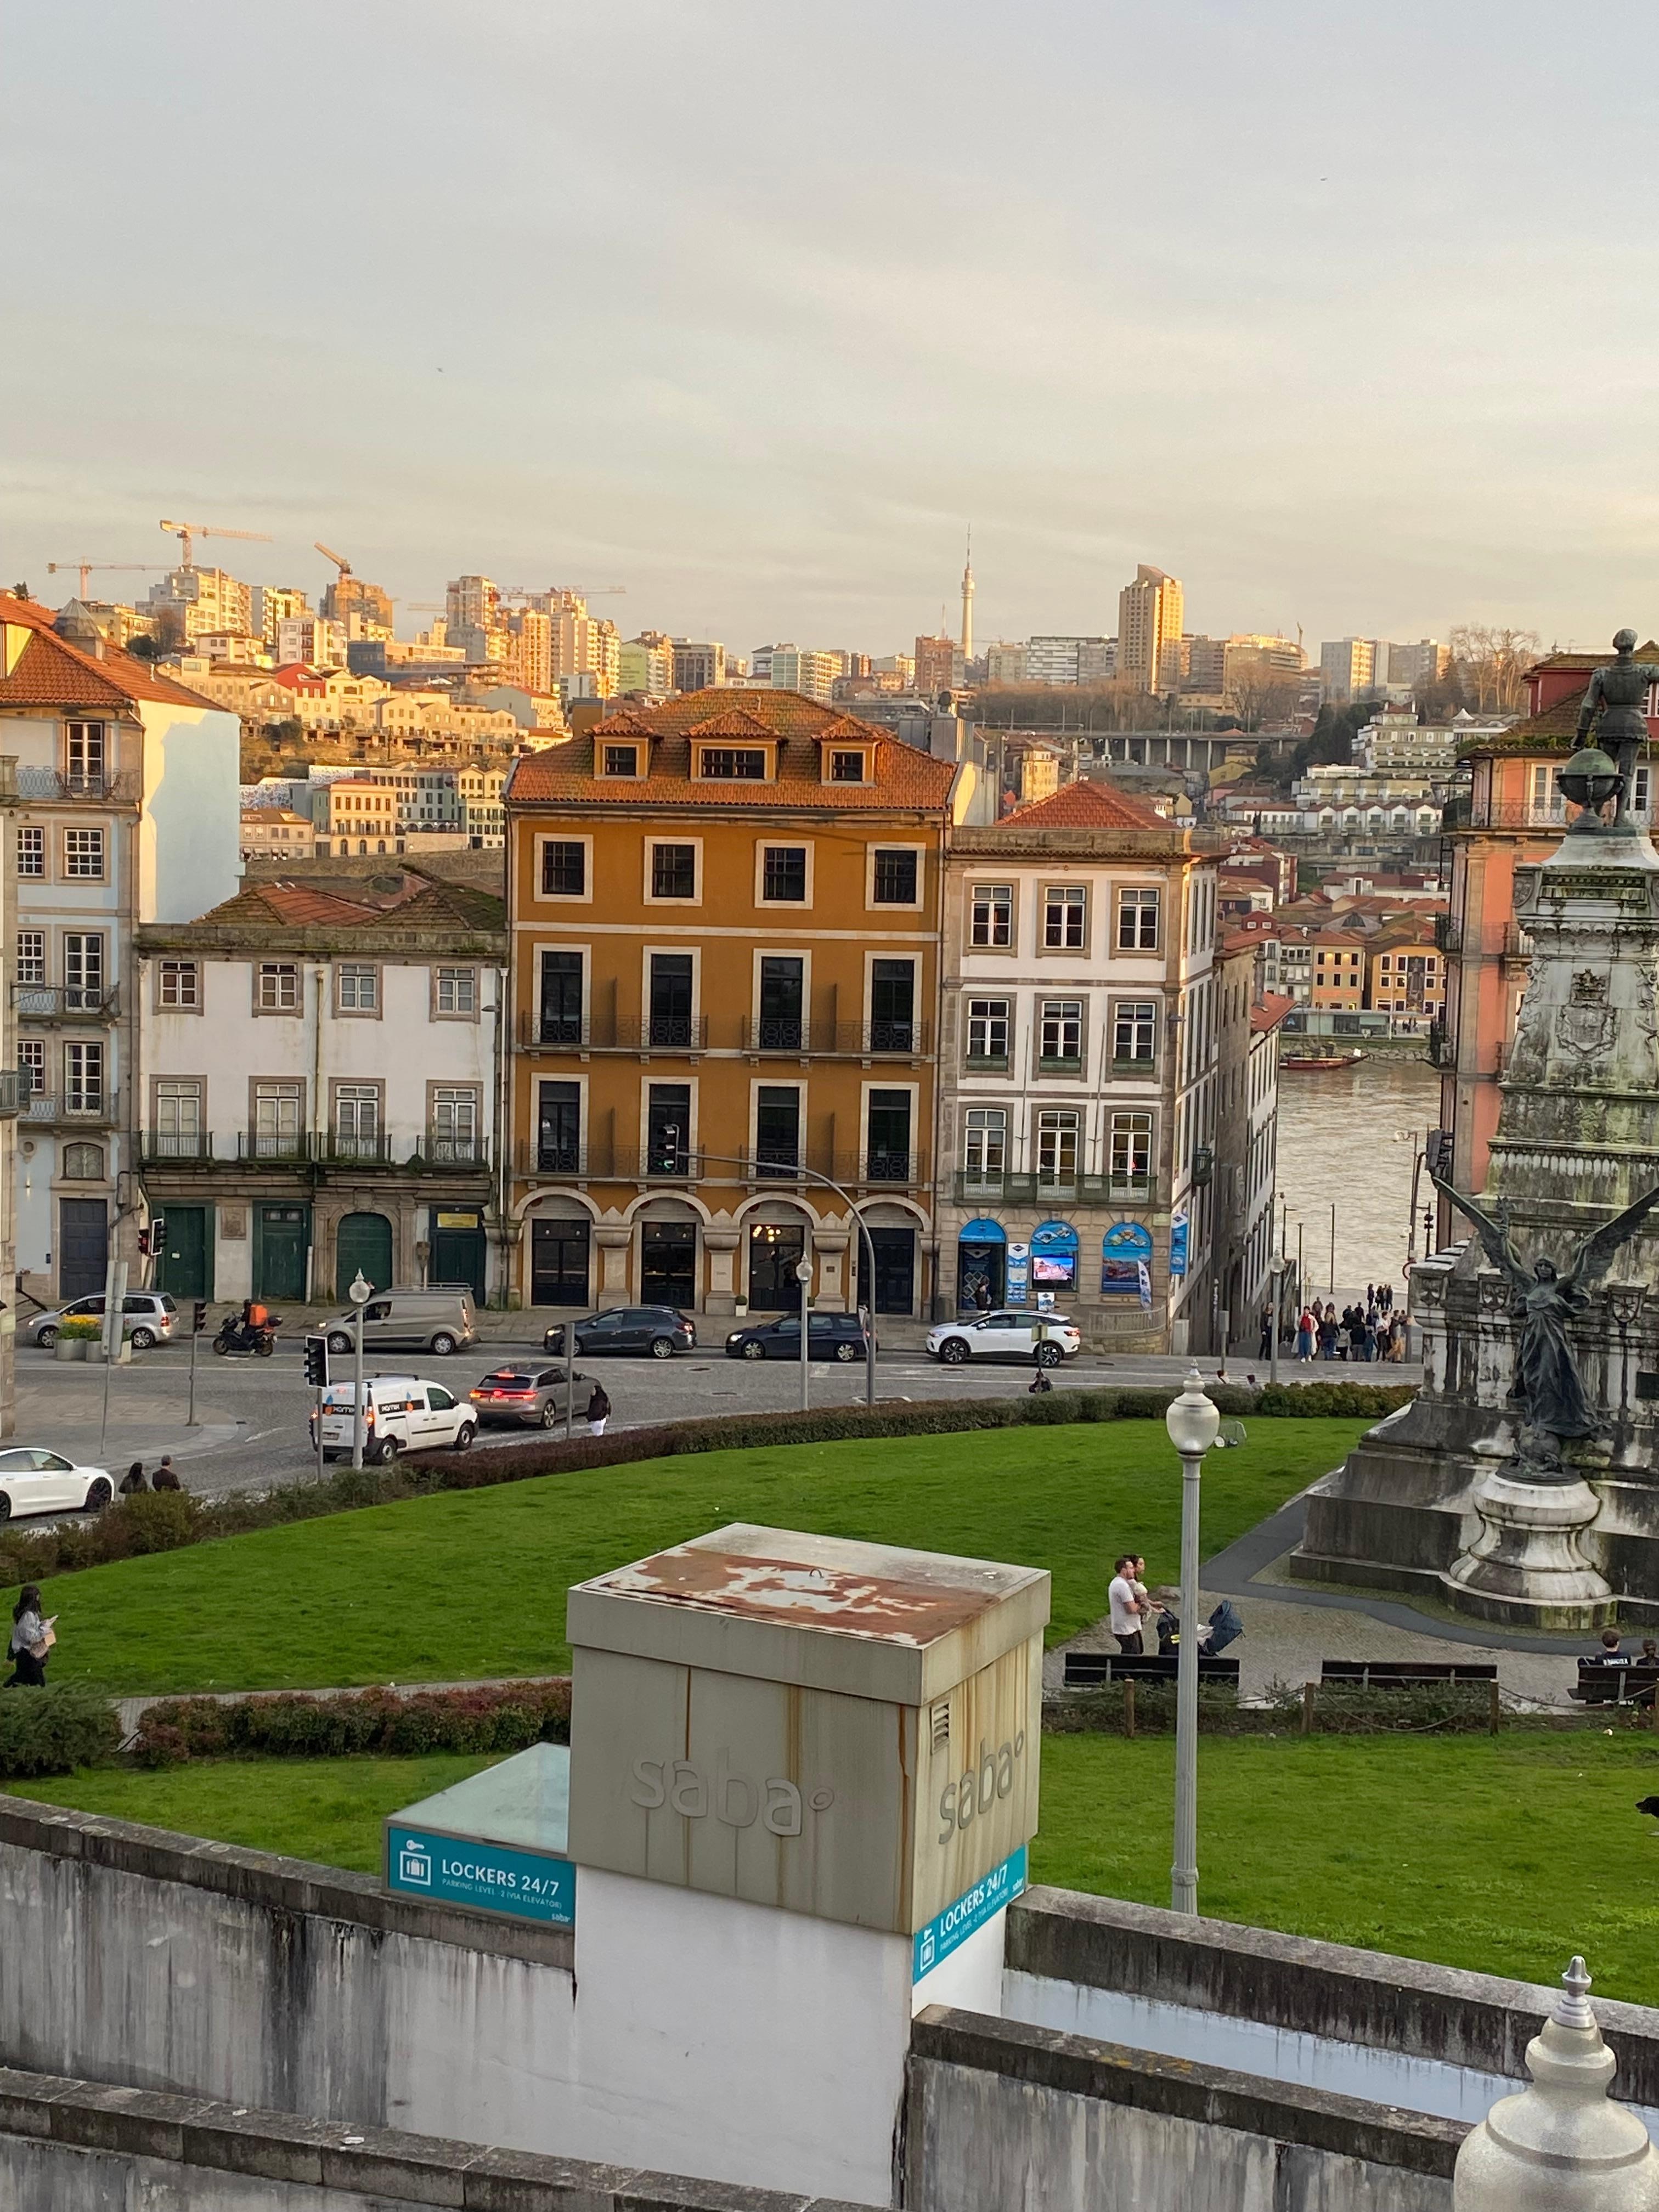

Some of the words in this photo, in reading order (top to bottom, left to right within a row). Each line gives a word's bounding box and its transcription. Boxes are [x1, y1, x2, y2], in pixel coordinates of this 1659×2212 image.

[442, 1859, 516, 1888] LOCKERS
[521, 1875, 559, 1896] 24/7
[442, 1878, 473, 1891] PARKING
[475, 1885, 494, 1895] LEVEL
[522, 1894, 562, 1910] ELEVATOR)
[940, 1884, 985, 1938] LOCKERS
[986, 1864, 1008, 1898] 24/7
